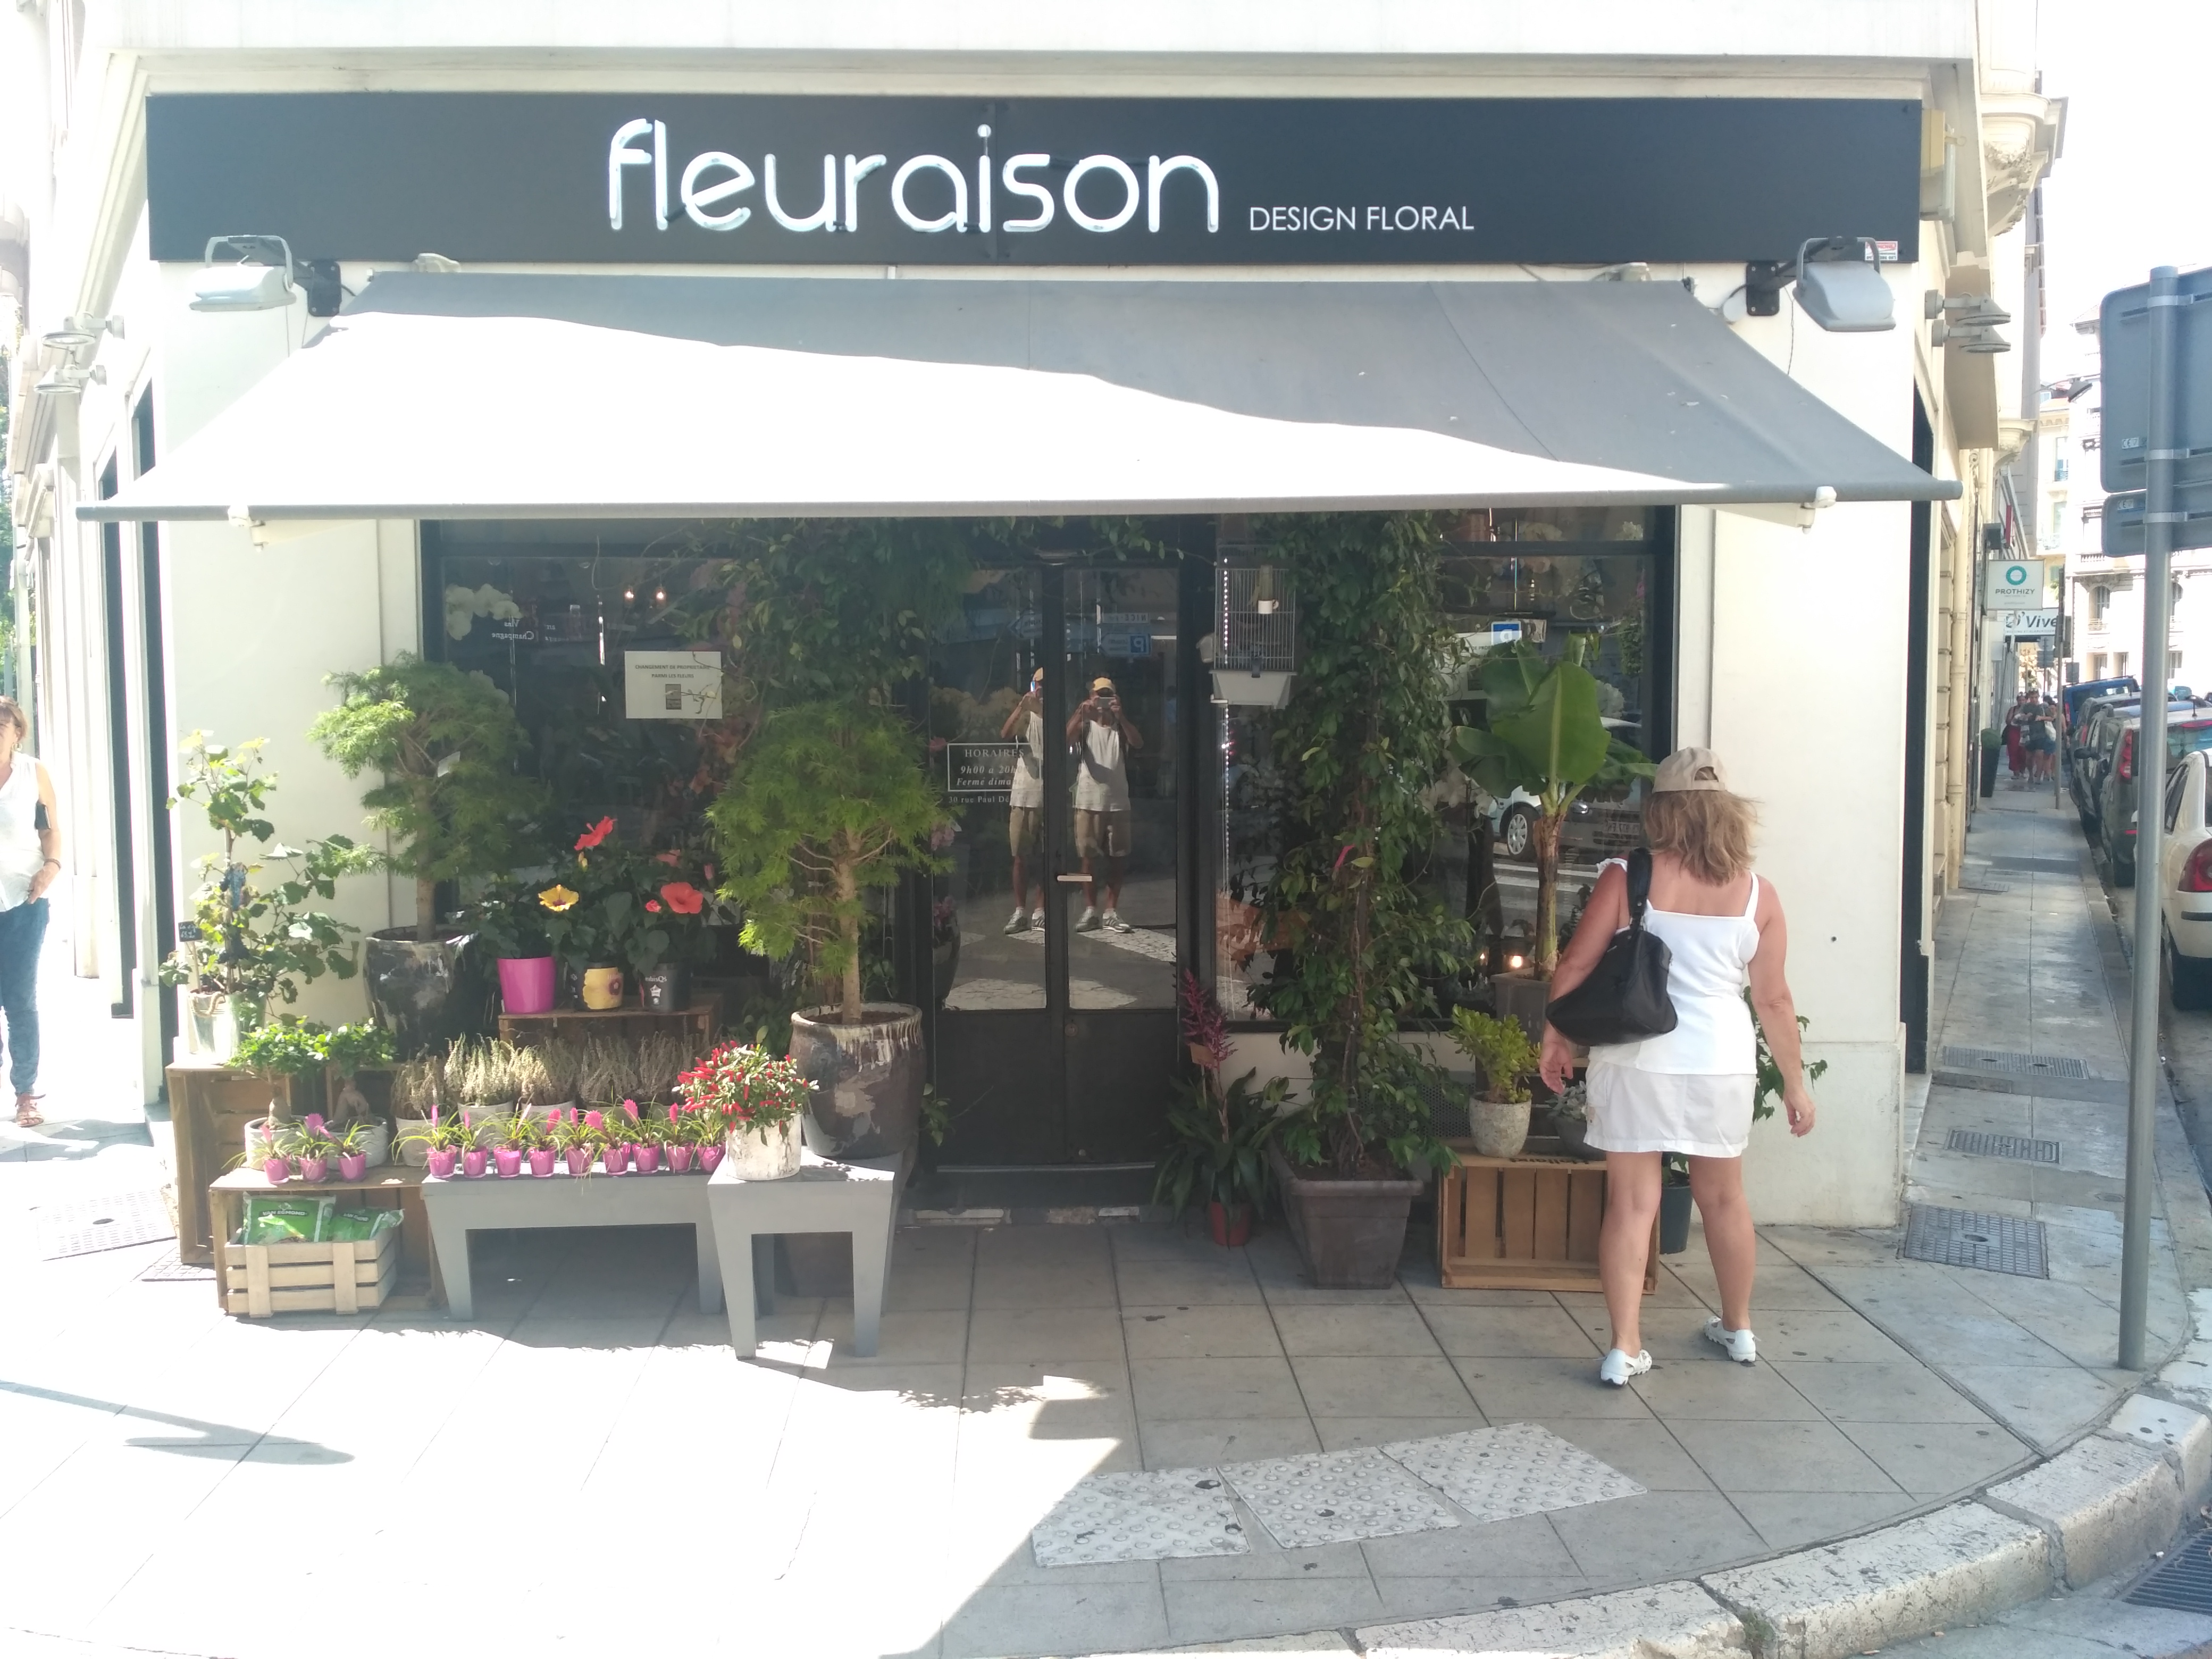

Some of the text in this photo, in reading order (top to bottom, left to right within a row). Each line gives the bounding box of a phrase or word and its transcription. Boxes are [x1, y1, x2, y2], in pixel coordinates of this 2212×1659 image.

[609, 118, 1219, 232] fleuraison
[1250, 206, 1474, 231] DESIGN FLORAL
[965, 749, 1024, 757] HORAIRES
[960, 765, 985, 774] 9h00
[957, 777, 985, 786] Fermé
